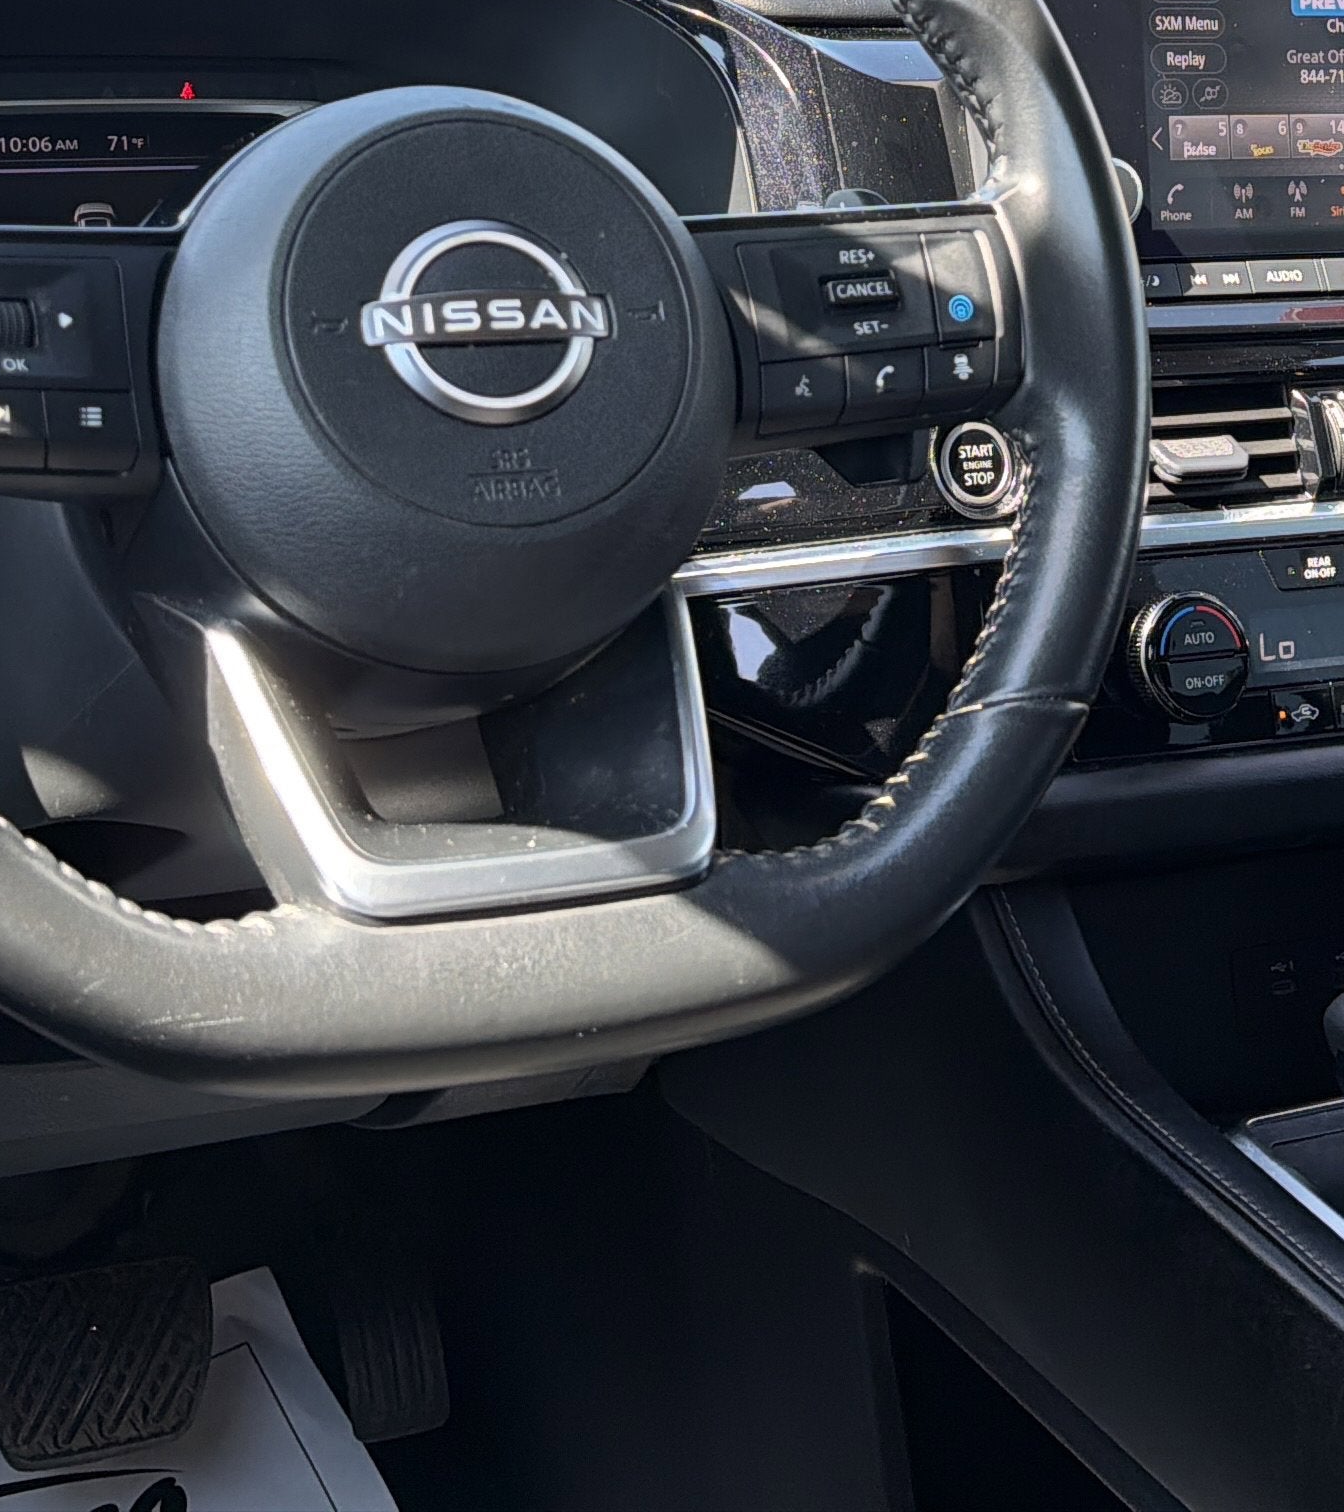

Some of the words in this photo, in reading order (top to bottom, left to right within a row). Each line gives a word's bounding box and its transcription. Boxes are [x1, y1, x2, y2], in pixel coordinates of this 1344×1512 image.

[1155, 16, 1183, 31] SXM
[1186, 17, 1219, 32] Menu
[1166, 51, 1206, 69] Replay
[1286, 49, 1325, 64] Great
[1175, 124, 1183, 135] 7
[1218, 121, 1227, 136] 5
[1236, 123, 1244, 135] 8
[1278, 120, 1287, 136] 6
[1295, 122, 1303, 134] 9
[0, 136, 52, 153] 10:06
[56, 139, 78, 150] AM
[1160, 209, 1192, 221] Phone
[1235, 209, 1253, 219] AM
[1290, 207, 1306, 218] FM
[839, 248, 875, 264] RES+
[1266, 269, 1303, 283] AUDIO
[836, 281, 893, 299] CANCEL
[372, 298, 606, 338] NISSAN
[2, 357, 29, 372] OK
[958, 443, 994, 459] START
[963, 459, 993, 470] ENGINE
[964, 471, 995, 487] STOP
[1307, 555, 1331, 568] REAR
[1184, 631, 1215, 646] AUTO
[1259, 632, 1295, 662] Lo
